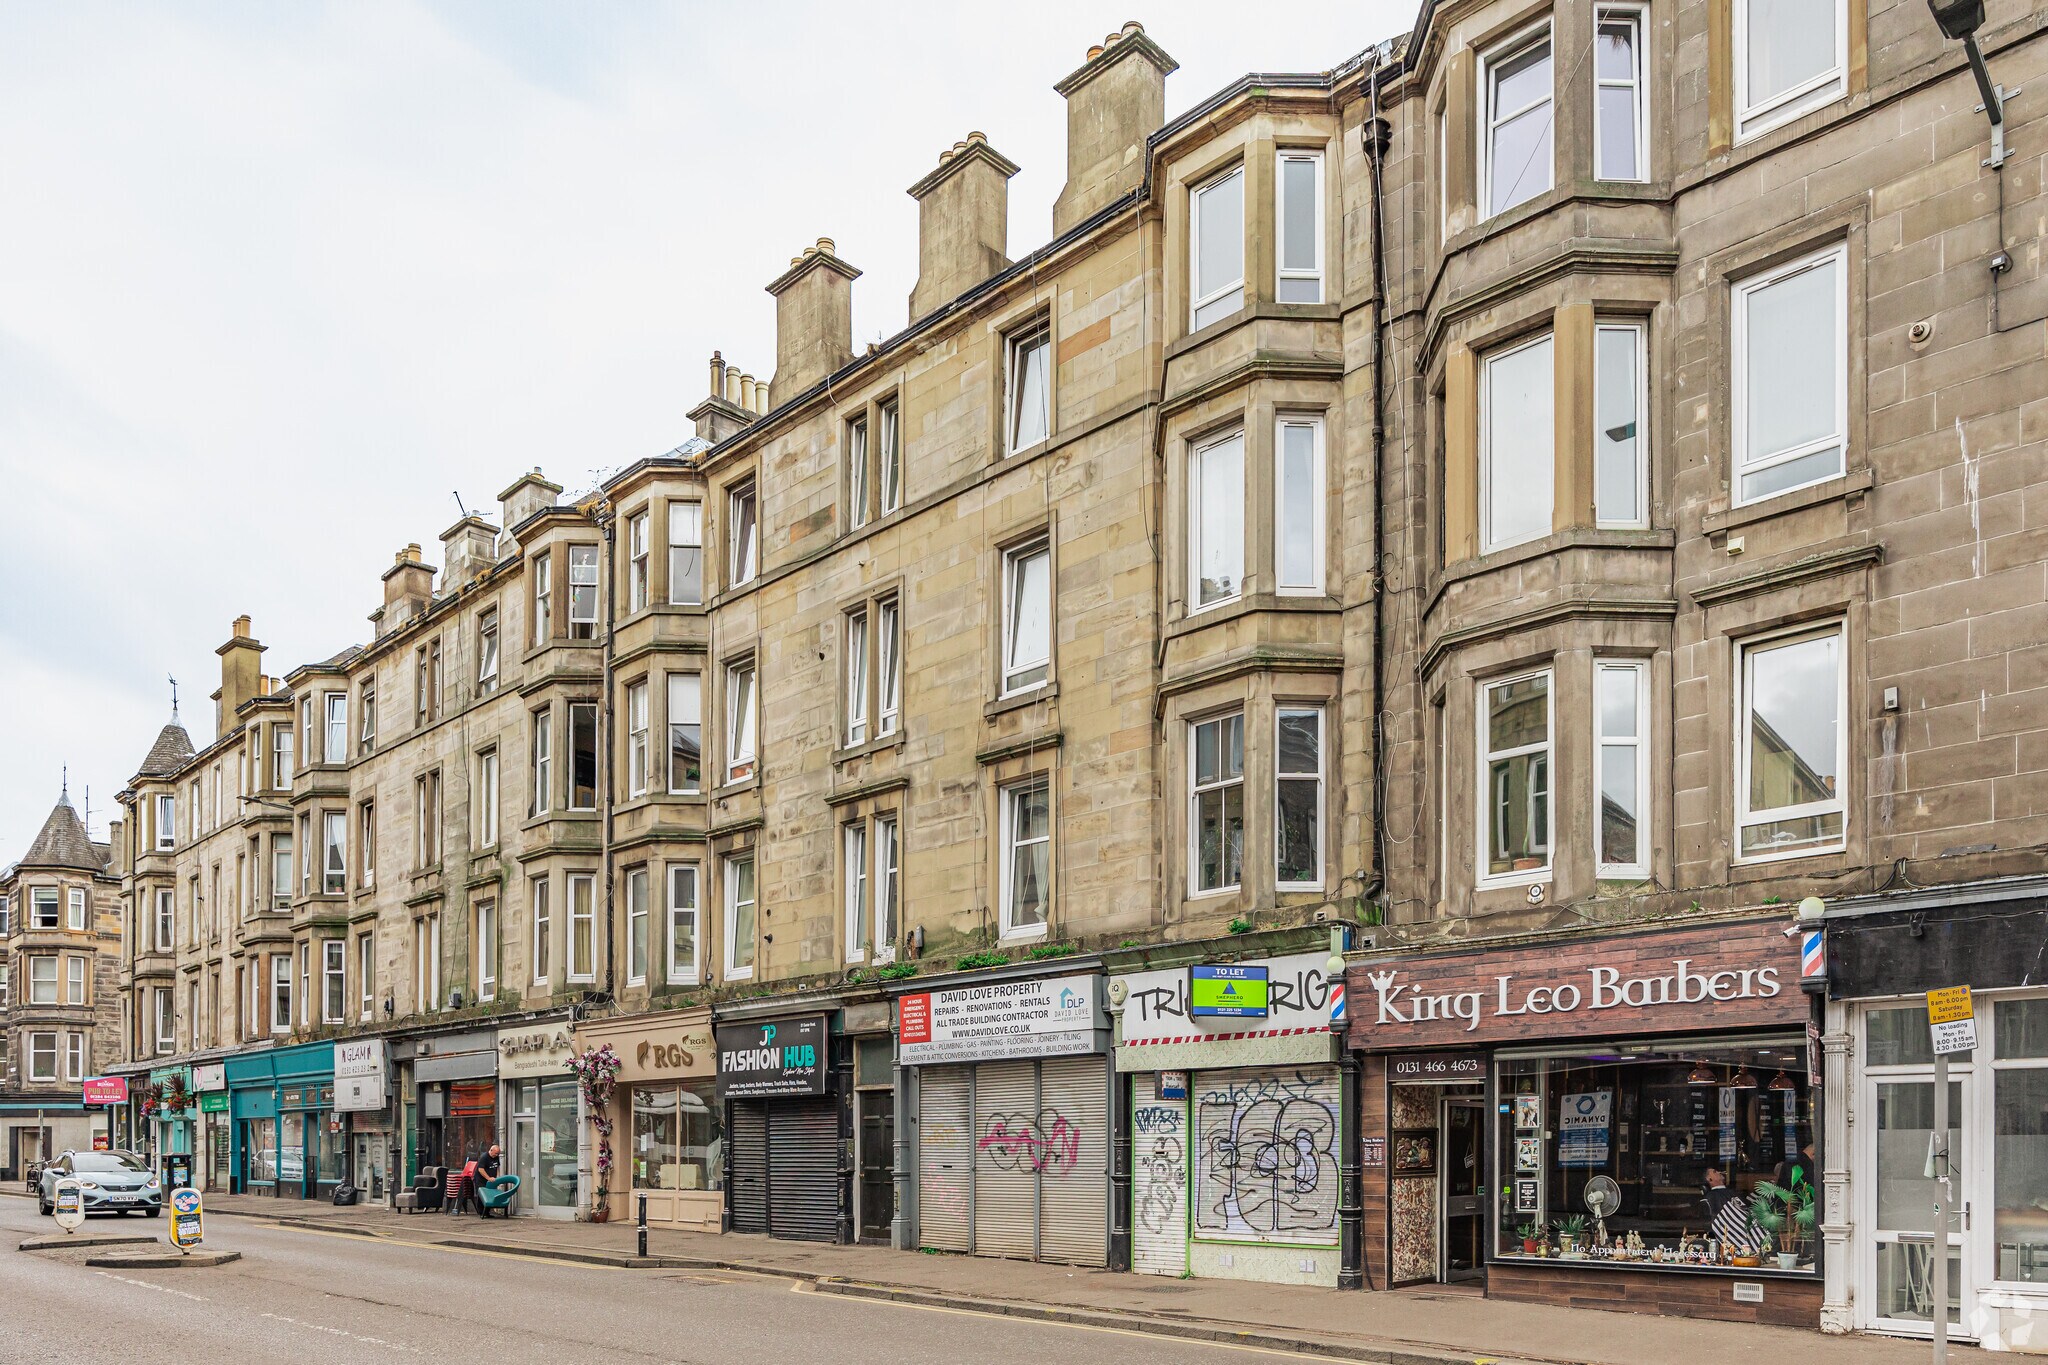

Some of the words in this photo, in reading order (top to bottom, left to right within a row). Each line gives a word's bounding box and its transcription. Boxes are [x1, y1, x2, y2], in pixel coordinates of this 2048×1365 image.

[941, 990, 968, 1003] DAVID
[970, 987, 992, 1000] LOVE
[994, 982, 1042, 997] PROPERTY
[1131, 979, 1189, 1021] TRI
[1373, 981, 1484, 1032] King
[1493, 975, 1581, 1016] Leo
[1586, 959, 1782, 1010] Barbers
[935, 1006, 959, 1016] REPAIRS
[966, 1001, 1012, 1012] RENOVATIONS
[1020, 997, 1050, 1007] RENTALS
[1067, 998, 1084, 1008] DLP
[949, 1018, 968, 1026] TRADE
[970, 1014, 1000, 1024] BUILDING
[1002, 1010, 1048, 1022] CONTRACTOR
[952, 1024, 1030, 1038] WWW.DAVIDLOVE.CO.UK
[903, 1054, 925, 1062] BASEMENT
[945, 1051, 978, 1059] CONVERSIONS
[1009, 1046, 1042, 1055] BATHROOMS
[1046, 1044, 1072, 1052] BUILDING
[909, 1044, 935, 1052] ELECTRICAL
[939, 1042, 963, 1050] PLUMBING
[980, 1039, 1003, 1047] PAINTING
[1007, 1037, 1033, 1045] FLOORING
[347, 1046, 366, 1062] GLAM
[653, 1043, 693, 1068] RGS
[722, 1048, 780, 1072] FASHION
[784, 1045, 815, 1068] HUB
[1396, 1062, 1420, 1073] 0131
[1425, 1060, 1446, 1072] 466
[1450, 1059, 1478, 1072] 4673
[1571, 1244, 1585, 1253] No
[1589, 1244, 1658, 1256] Appointment
[1662, 1247, 1716, 1260] Necessary
